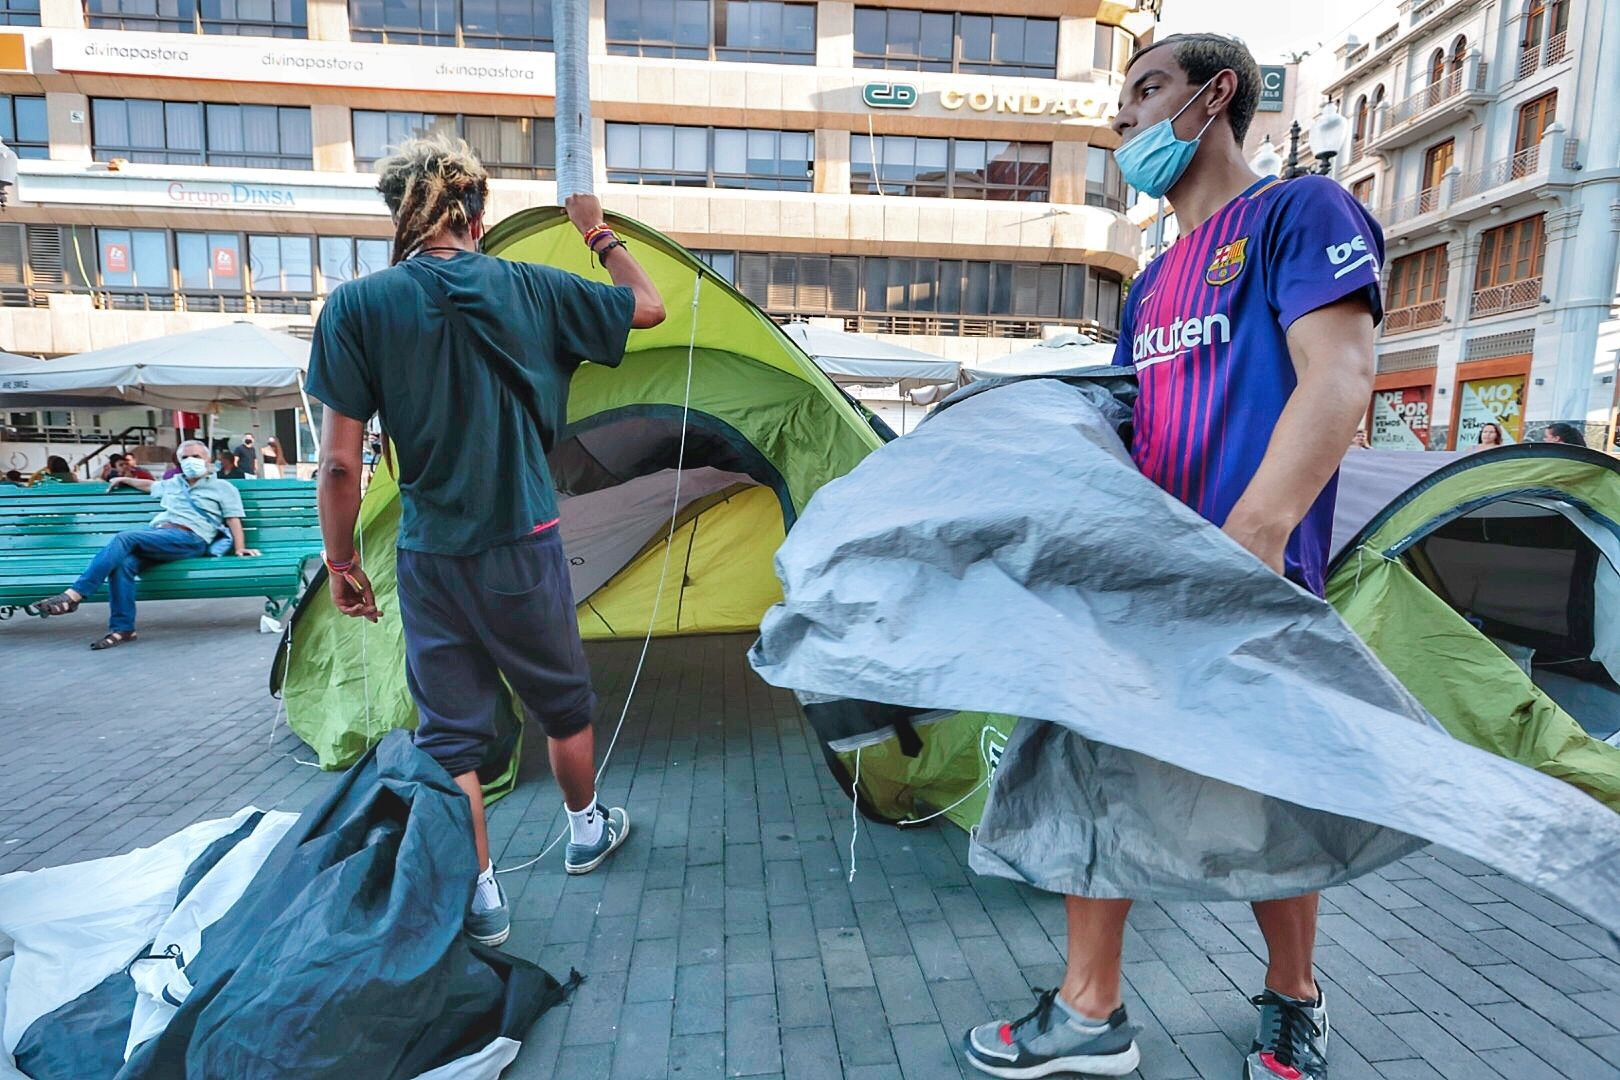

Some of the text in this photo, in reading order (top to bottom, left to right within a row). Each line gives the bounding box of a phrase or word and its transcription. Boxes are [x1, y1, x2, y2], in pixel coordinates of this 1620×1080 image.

[167, 181, 296, 207] Grupo DINSA
[1132, 312, 1231, 362] akuten
[1384, 391, 1403, 404] DE
[1478, 383, 1513, 401] MO
[1395, 402, 1428, 416] POR
[1488, 400, 1520, 416] DA
